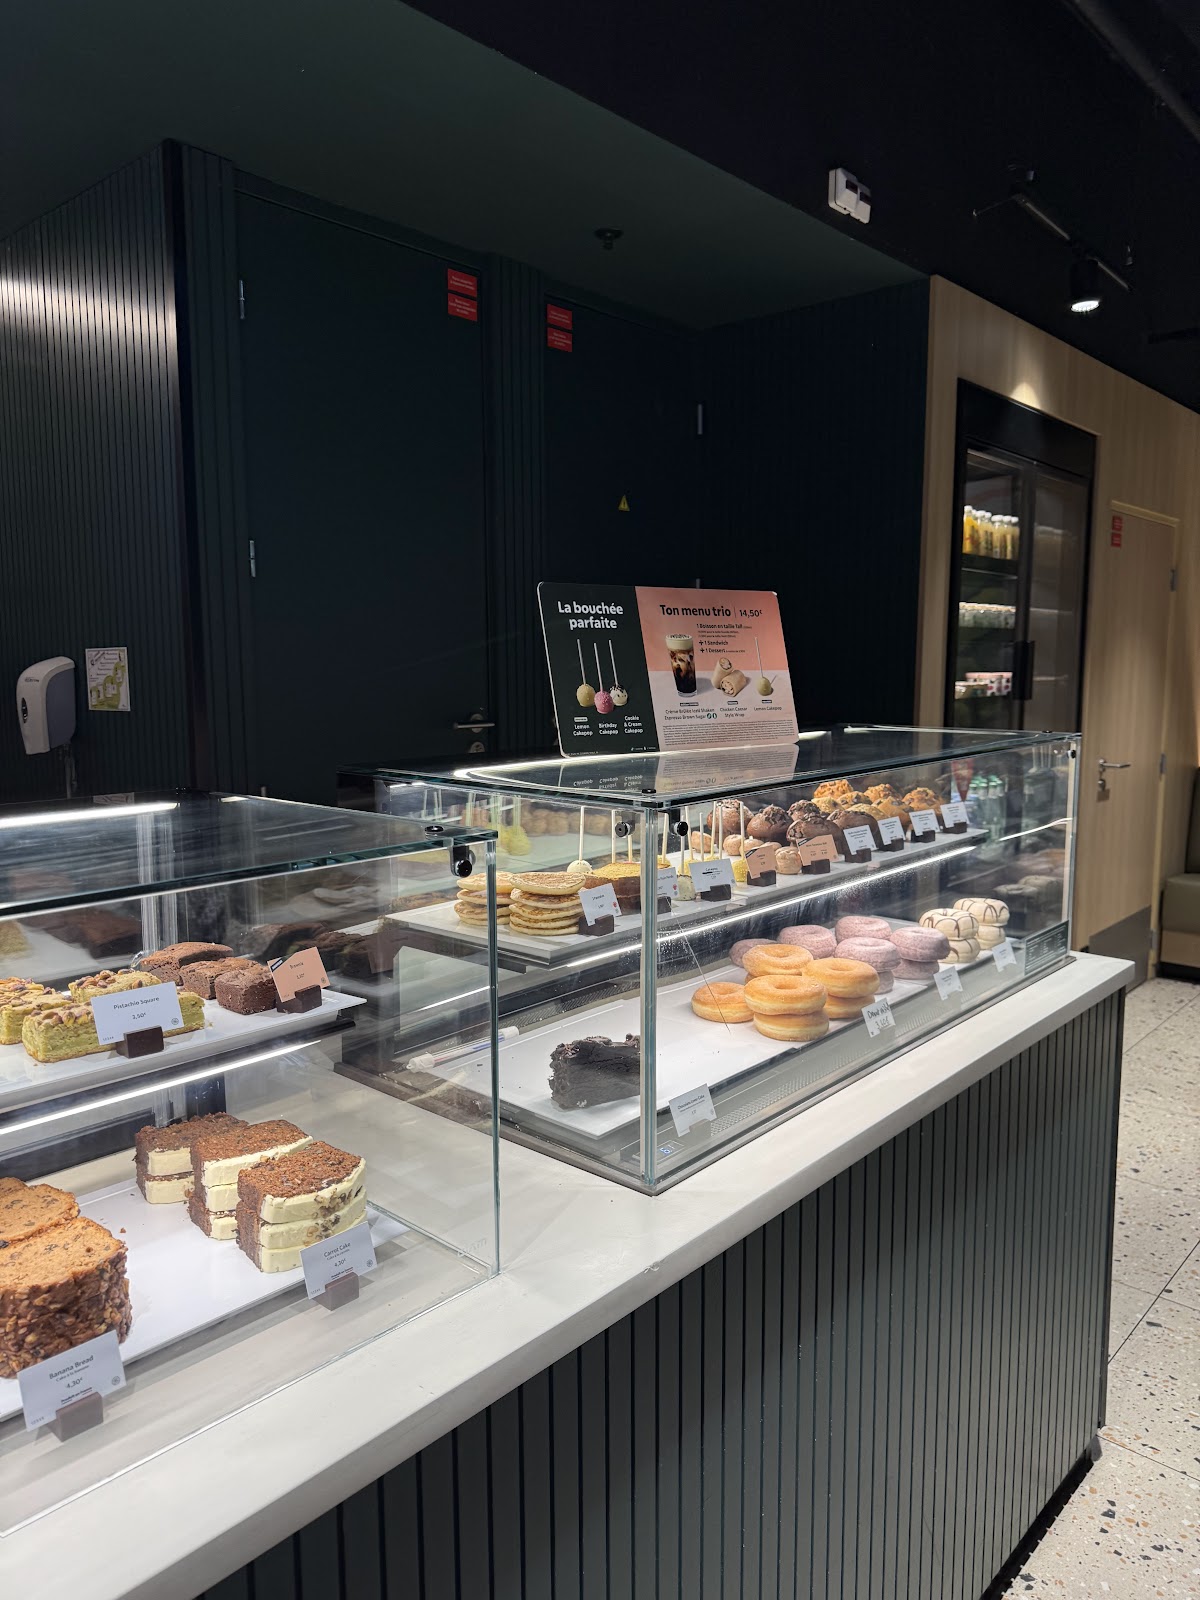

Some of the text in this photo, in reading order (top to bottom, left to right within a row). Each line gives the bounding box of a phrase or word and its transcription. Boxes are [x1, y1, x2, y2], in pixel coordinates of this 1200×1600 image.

[558, 601, 623, 614] La bouchée
[660, 605, 680, 616] Ton
[682, 607, 711, 616] menu
[712, 606, 731, 617] trio
[569, 616, 617, 630] parfaite
[113, 996, 160, 1010] Pistachio Square
[324, 1242, 351, 1257] Carrot Cake
[49, 1355, 94, 1379] Banana Bread
